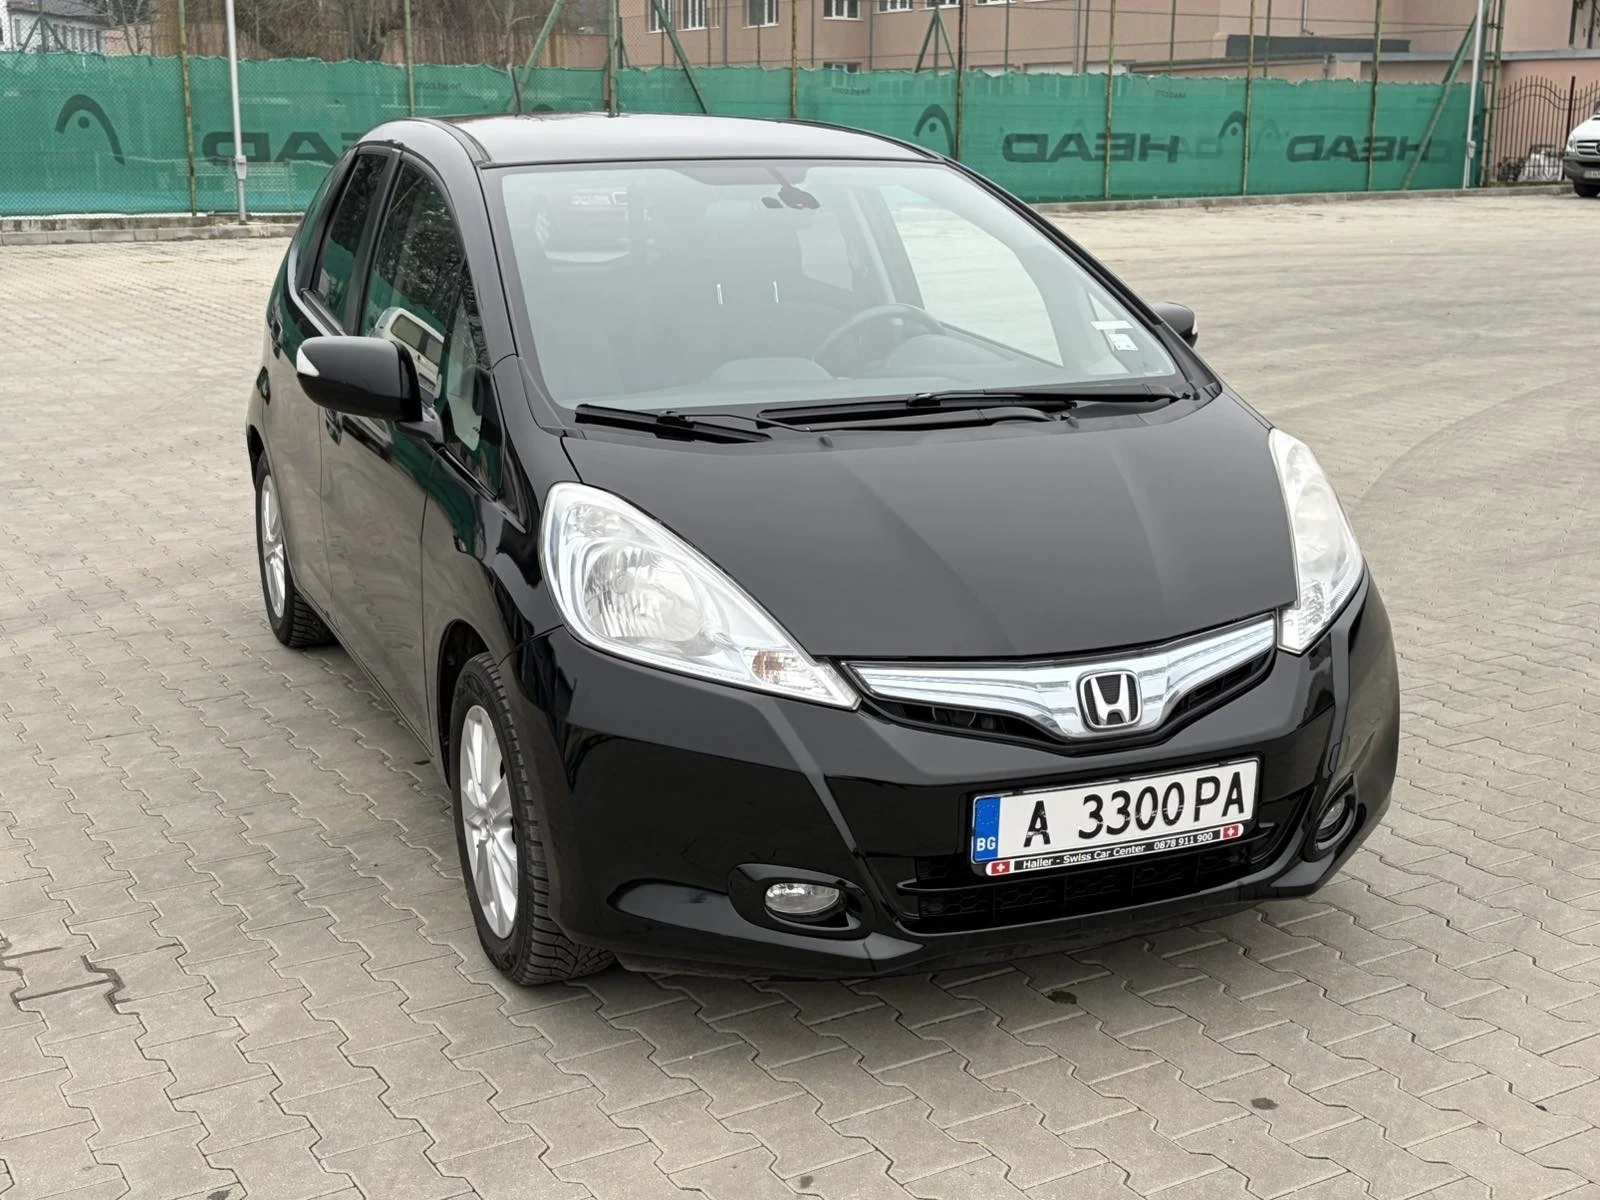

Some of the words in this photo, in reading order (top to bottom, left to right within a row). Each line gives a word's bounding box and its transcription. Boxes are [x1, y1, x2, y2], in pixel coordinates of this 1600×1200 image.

[1023, 800, 1051, 848] A
[976, 837, 996, 852] BG
[1022, 858, 1053, 869] Haller
[1063, 852, 1092, 864] Swiss
[1094, 850, 1111, 860] Car
[1113, 844, 1146, 856] Center
[1153, 838, 1176, 850] 0878
[1178, 836, 1195, 847] 911
[1197, 832, 1213, 843] 900
